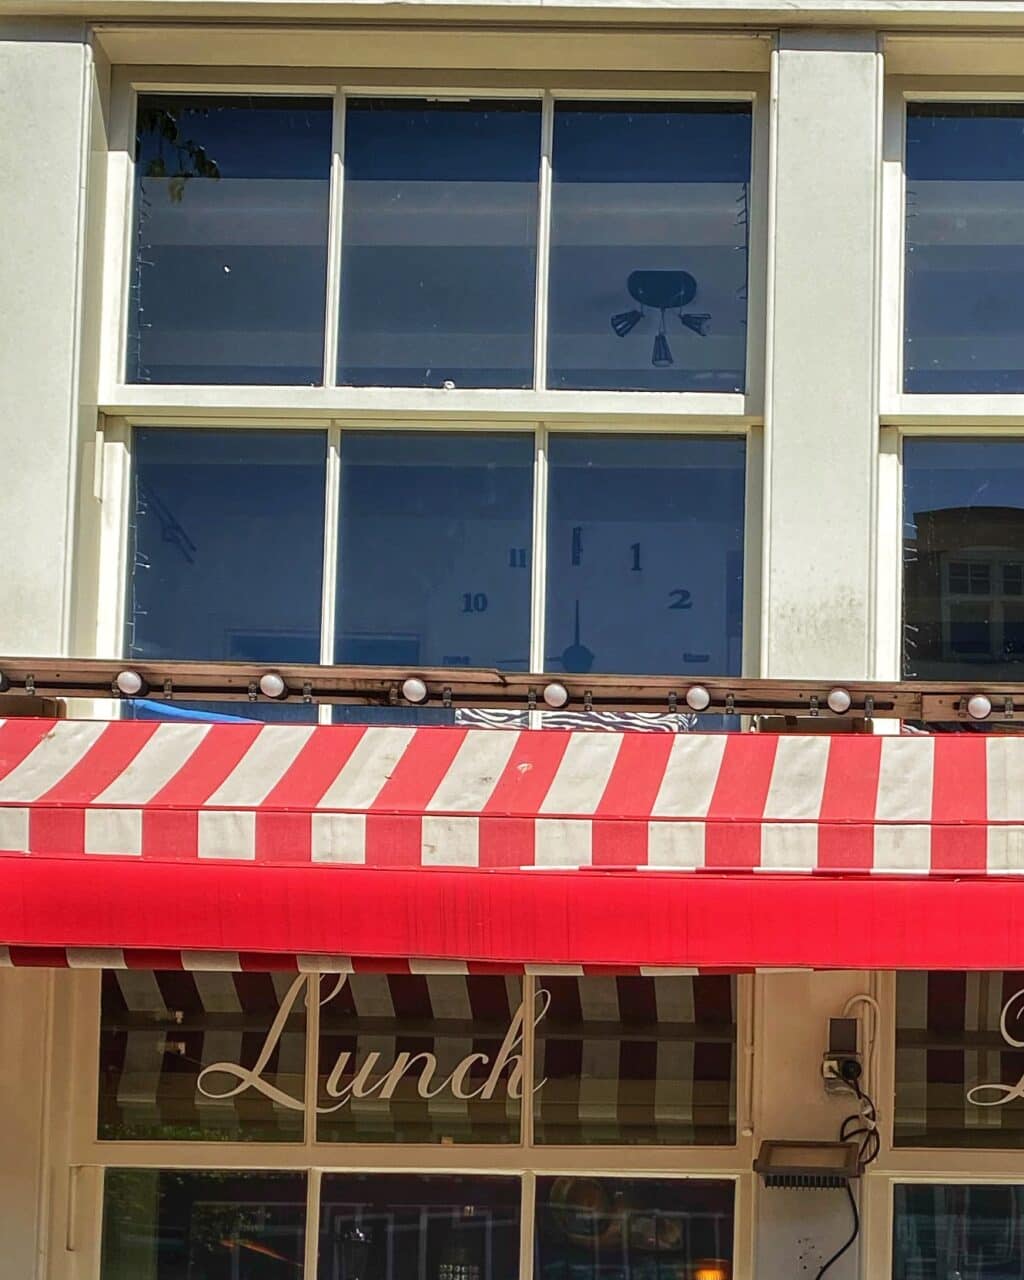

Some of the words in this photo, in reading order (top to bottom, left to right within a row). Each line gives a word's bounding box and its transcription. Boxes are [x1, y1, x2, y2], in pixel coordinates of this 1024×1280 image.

[461, 592, 488, 613] 10
[668, 589, 693, 609] 2
[197, 972, 551, 1113] Lunch
